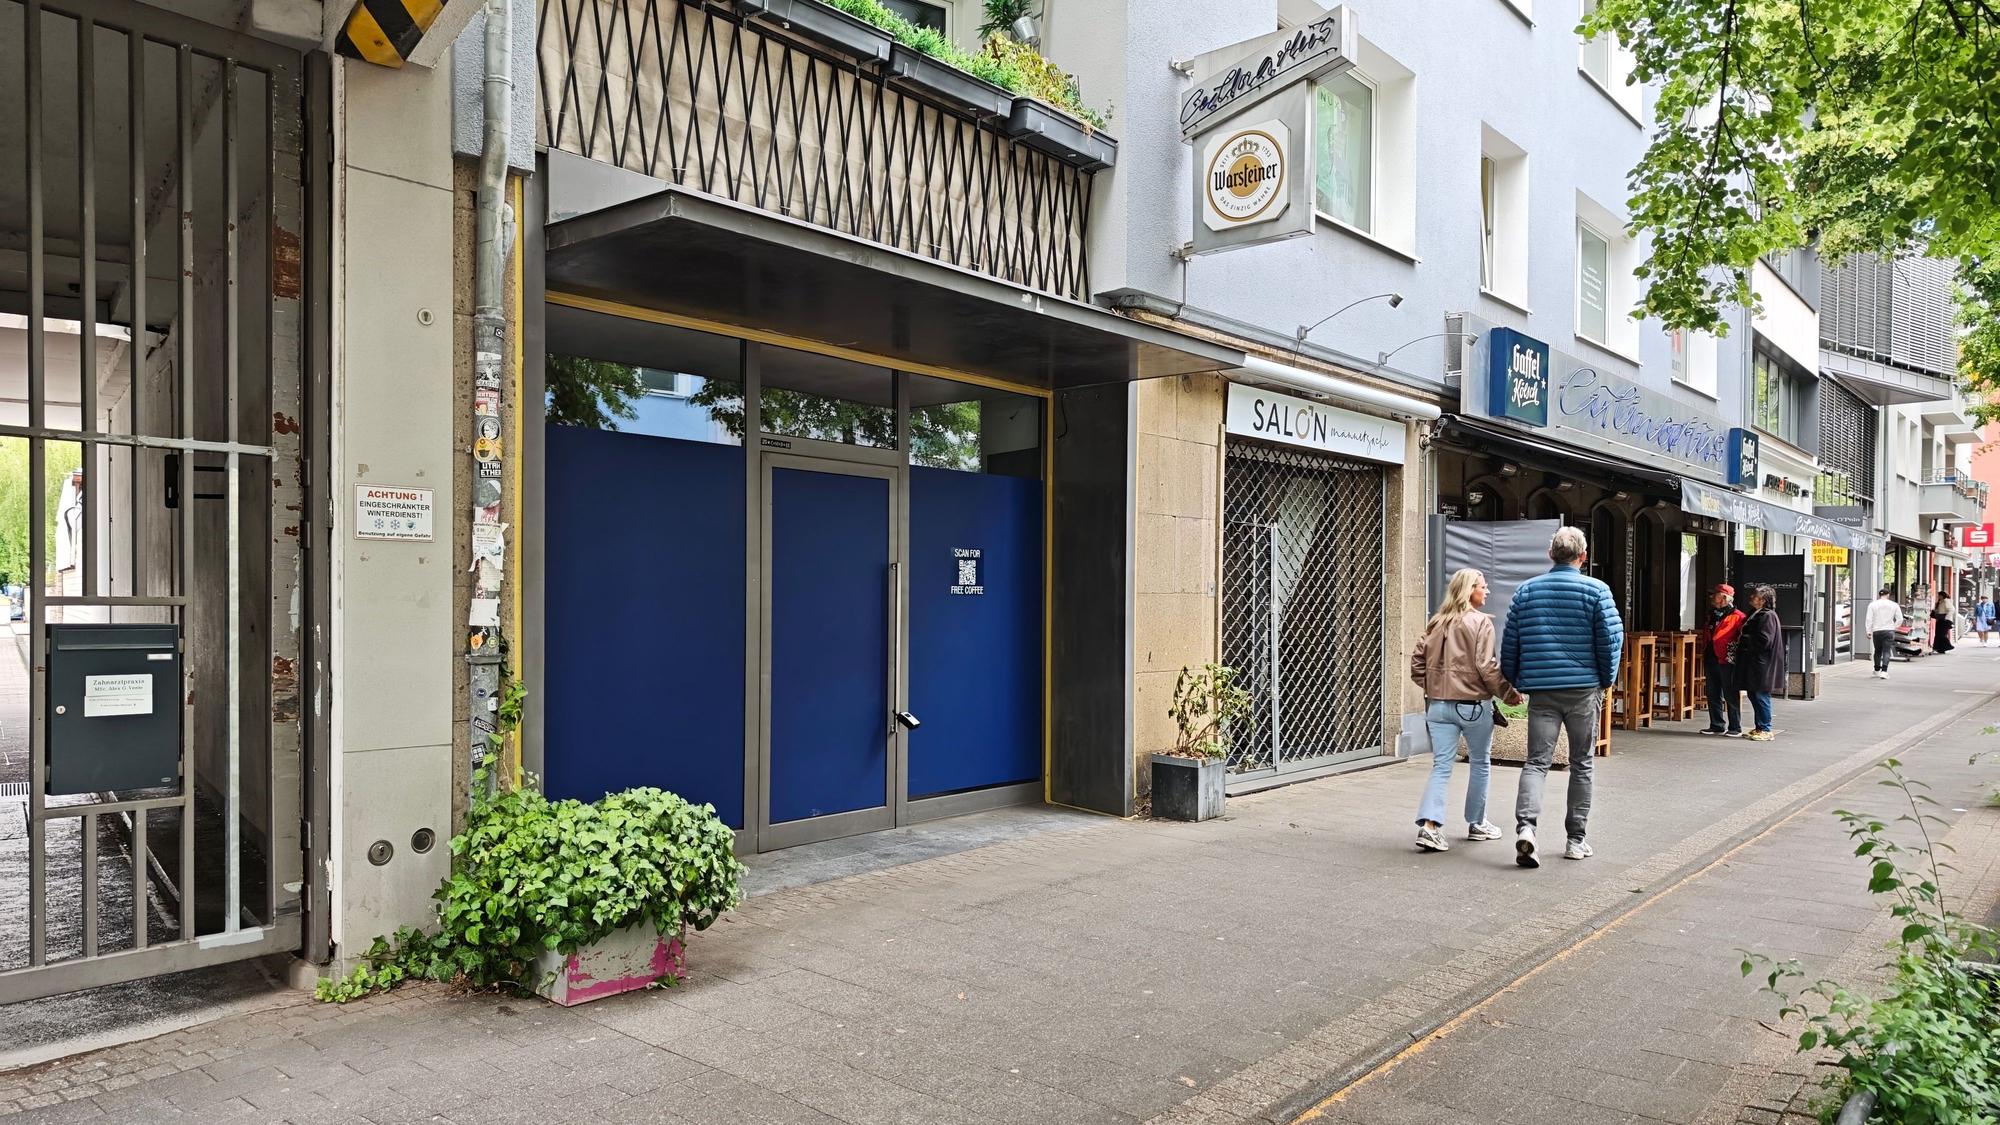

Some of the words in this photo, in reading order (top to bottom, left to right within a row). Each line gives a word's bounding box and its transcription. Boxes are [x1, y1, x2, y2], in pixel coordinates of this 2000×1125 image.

[1214, 163, 1278, 191] Warsteiner
[1512, 343, 1540, 381] Gaffel
[1511, 377, 1540, 408] Kölsch
[1253, 399, 1327, 443] SALON
[367, 490, 417, 500] ACHTUNG
[359, 501, 430, 511] EINGESCHRÄNKTER
[367, 510, 423, 518] WINTERDIENST!
[954, 548, 969, 558] SCAN
[970, 549, 981, 558] FOR
[951, 586, 964, 594] FREE
[964, 586, 984, 594] COFFEE
